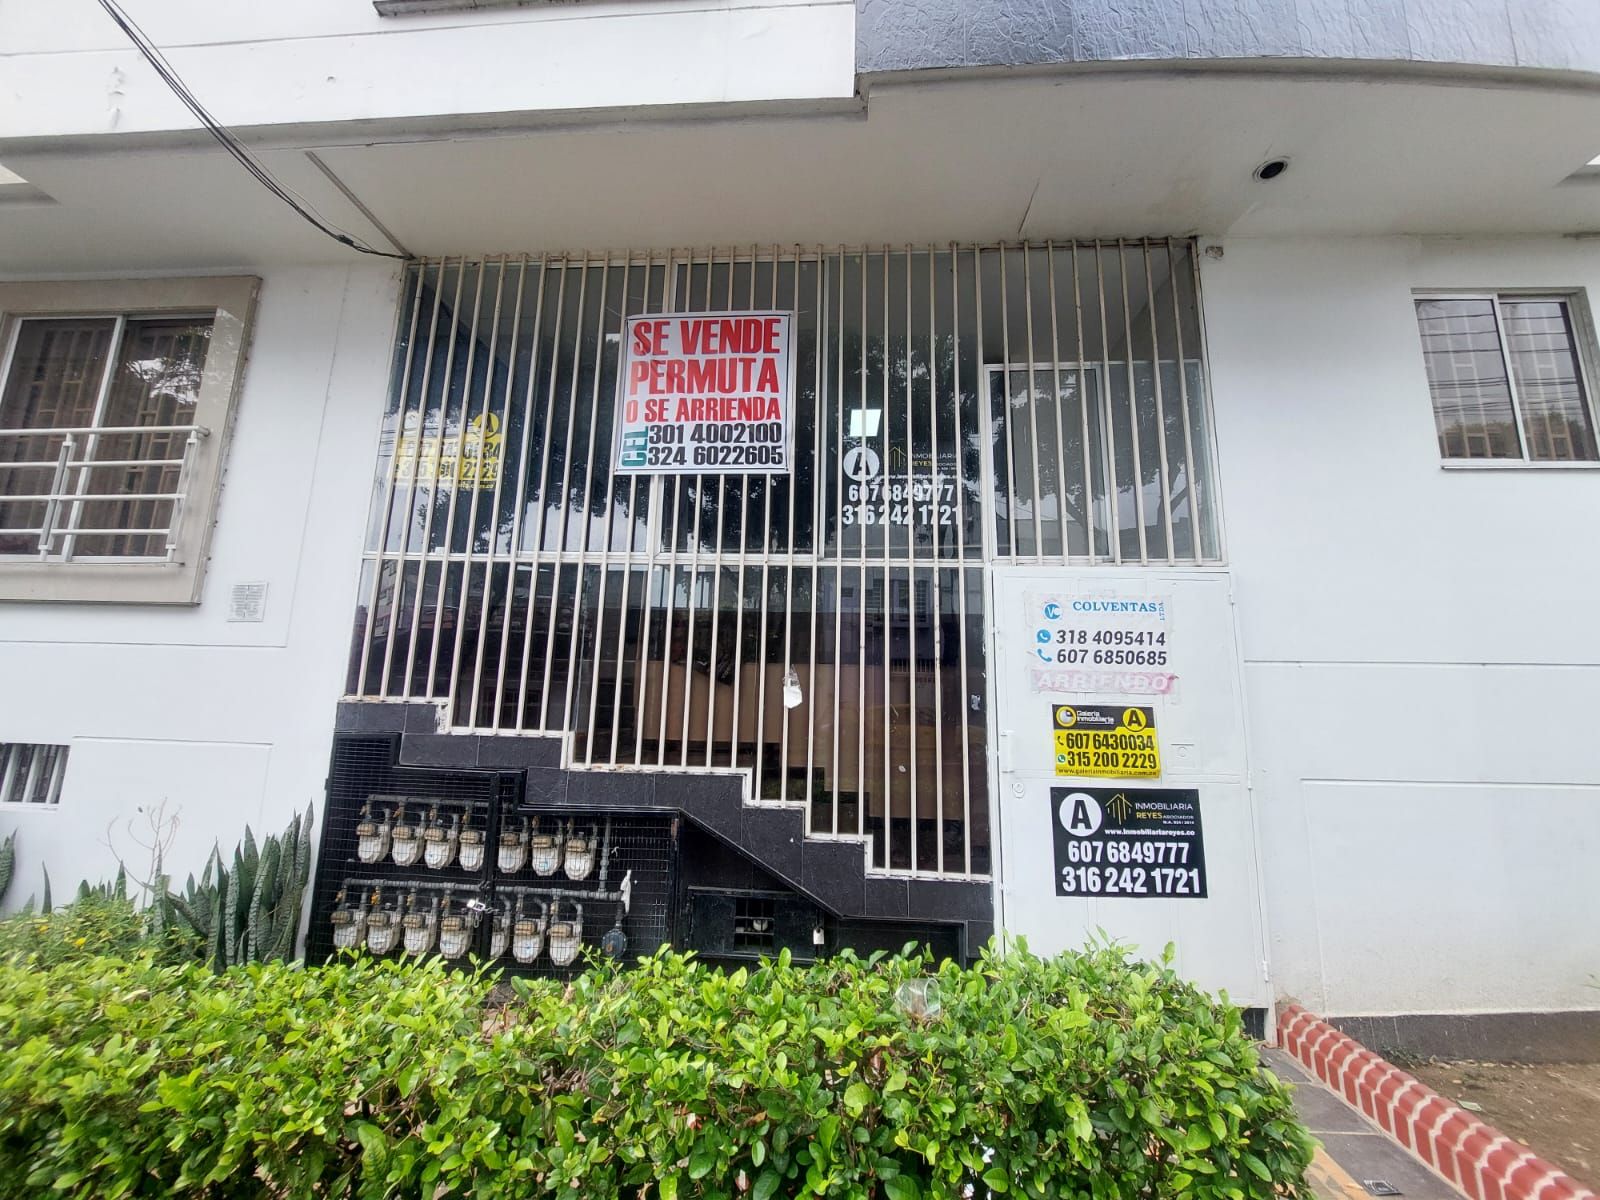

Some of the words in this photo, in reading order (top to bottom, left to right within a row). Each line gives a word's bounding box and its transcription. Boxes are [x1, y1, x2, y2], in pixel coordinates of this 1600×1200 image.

[633, 320, 671, 356] SE
[680, 318, 782, 355] VENDE
[629, 357, 780, 396] PERMUTA
[626, 399, 639, 424] O
[644, 398, 670, 423] SE
[675, 396, 781, 423] ARRIENDA
[649, 424, 685, 445] 301
[690, 422, 782, 444] 4002100
[621, 426, 648, 467] CEL
[647, 446, 687, 466] 324
[693, 445, 783, 466] 6022605
[1072, 601, 1157, 613] COLVENTAS
[1056, 629, 1088, 645] 318
[1092, 630, 1166, 646] 4095414
[1057, 649, 1089, 664] 607
[1093, 650, 1167, 666] 6850685
[1038, 673, 1169, 691] ARRIENDO
[1127, 709, 1142, 727] A
[1066, 733, 1090, 750] 607
[1092, 734, 1154, 751] 6430034
[1067, 751, 1091, 767] 315
[1093, 752, 1119, 768] 200
[1122, 753, 1157, 769] 2229
[1070, 799, 1092, 830] A
[1135, 802, 1193, 811] INMOBILIARIA
[1136, 812, 1162, 820] REYES
[1068, 841, 1104, 863] 607
[1106, 841, 1190, 864] 6849777
[1062, 866, 1102, 893] 316
[1104, 866, 1148, 893] 242
[1150, 867, 1201, 894] 1721
